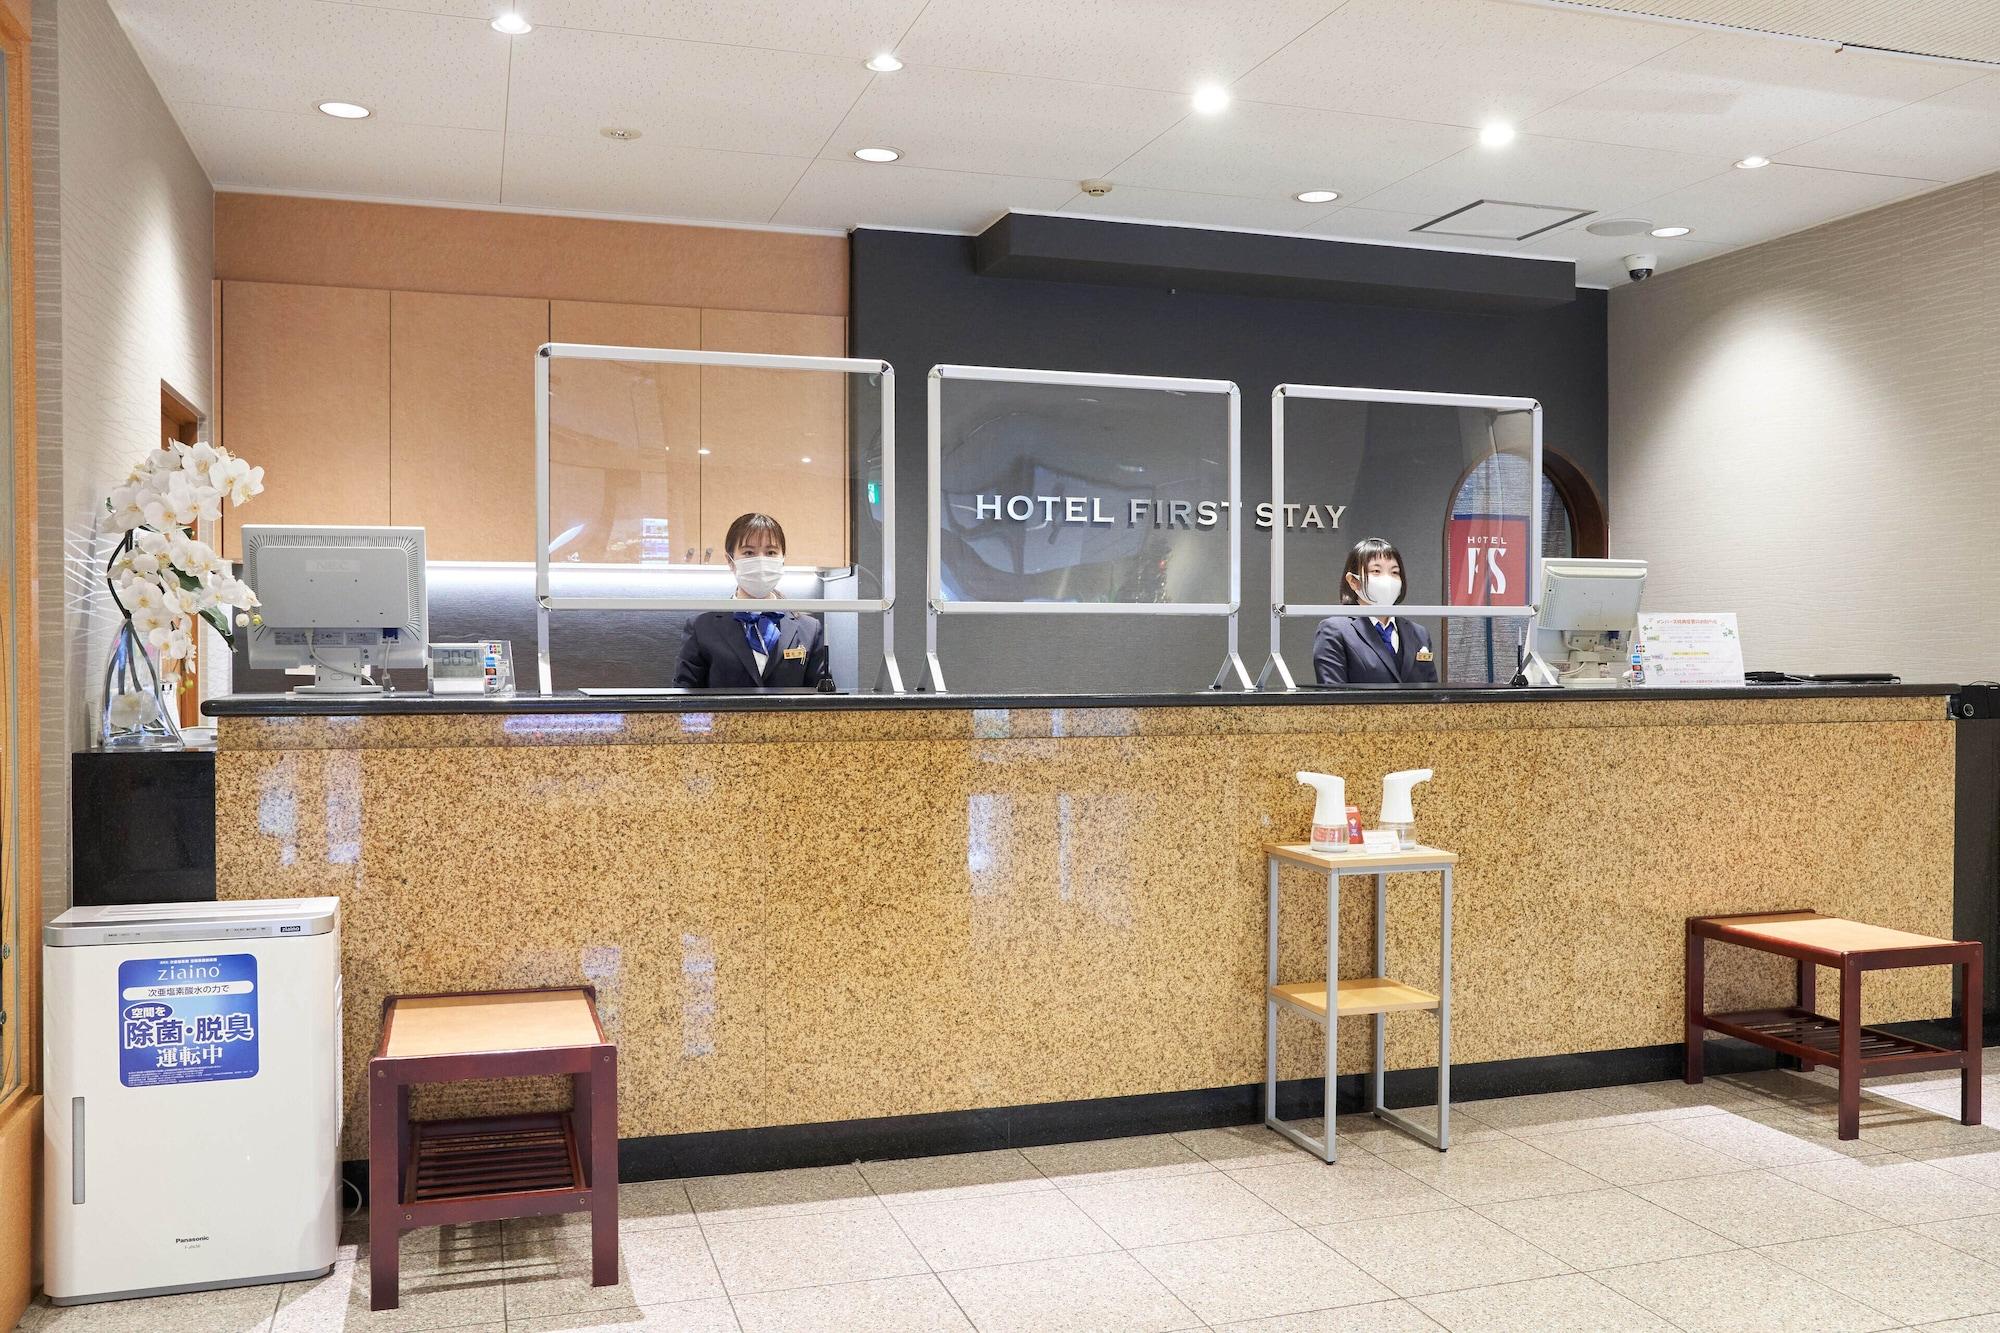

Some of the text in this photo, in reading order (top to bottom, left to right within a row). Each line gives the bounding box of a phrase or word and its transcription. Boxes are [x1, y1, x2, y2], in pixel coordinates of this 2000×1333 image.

[975, 494, 1115, 524] HOTEL
[1255, 502, 1347, 529] STAY
[1467, 536, 1508, 545] HOTEL
[158, 964, 220, 981] ziaino
[148, 984, 230, 997] 次亜塩素酸水の力で
[131, 1006, 166, 1019] 空間を
[126, 1014, 253, 1047] 除菌・脱臭
[156, 1044, 223, 1068] 運転中
[175, 1236, 209, 1244] Panasonic
